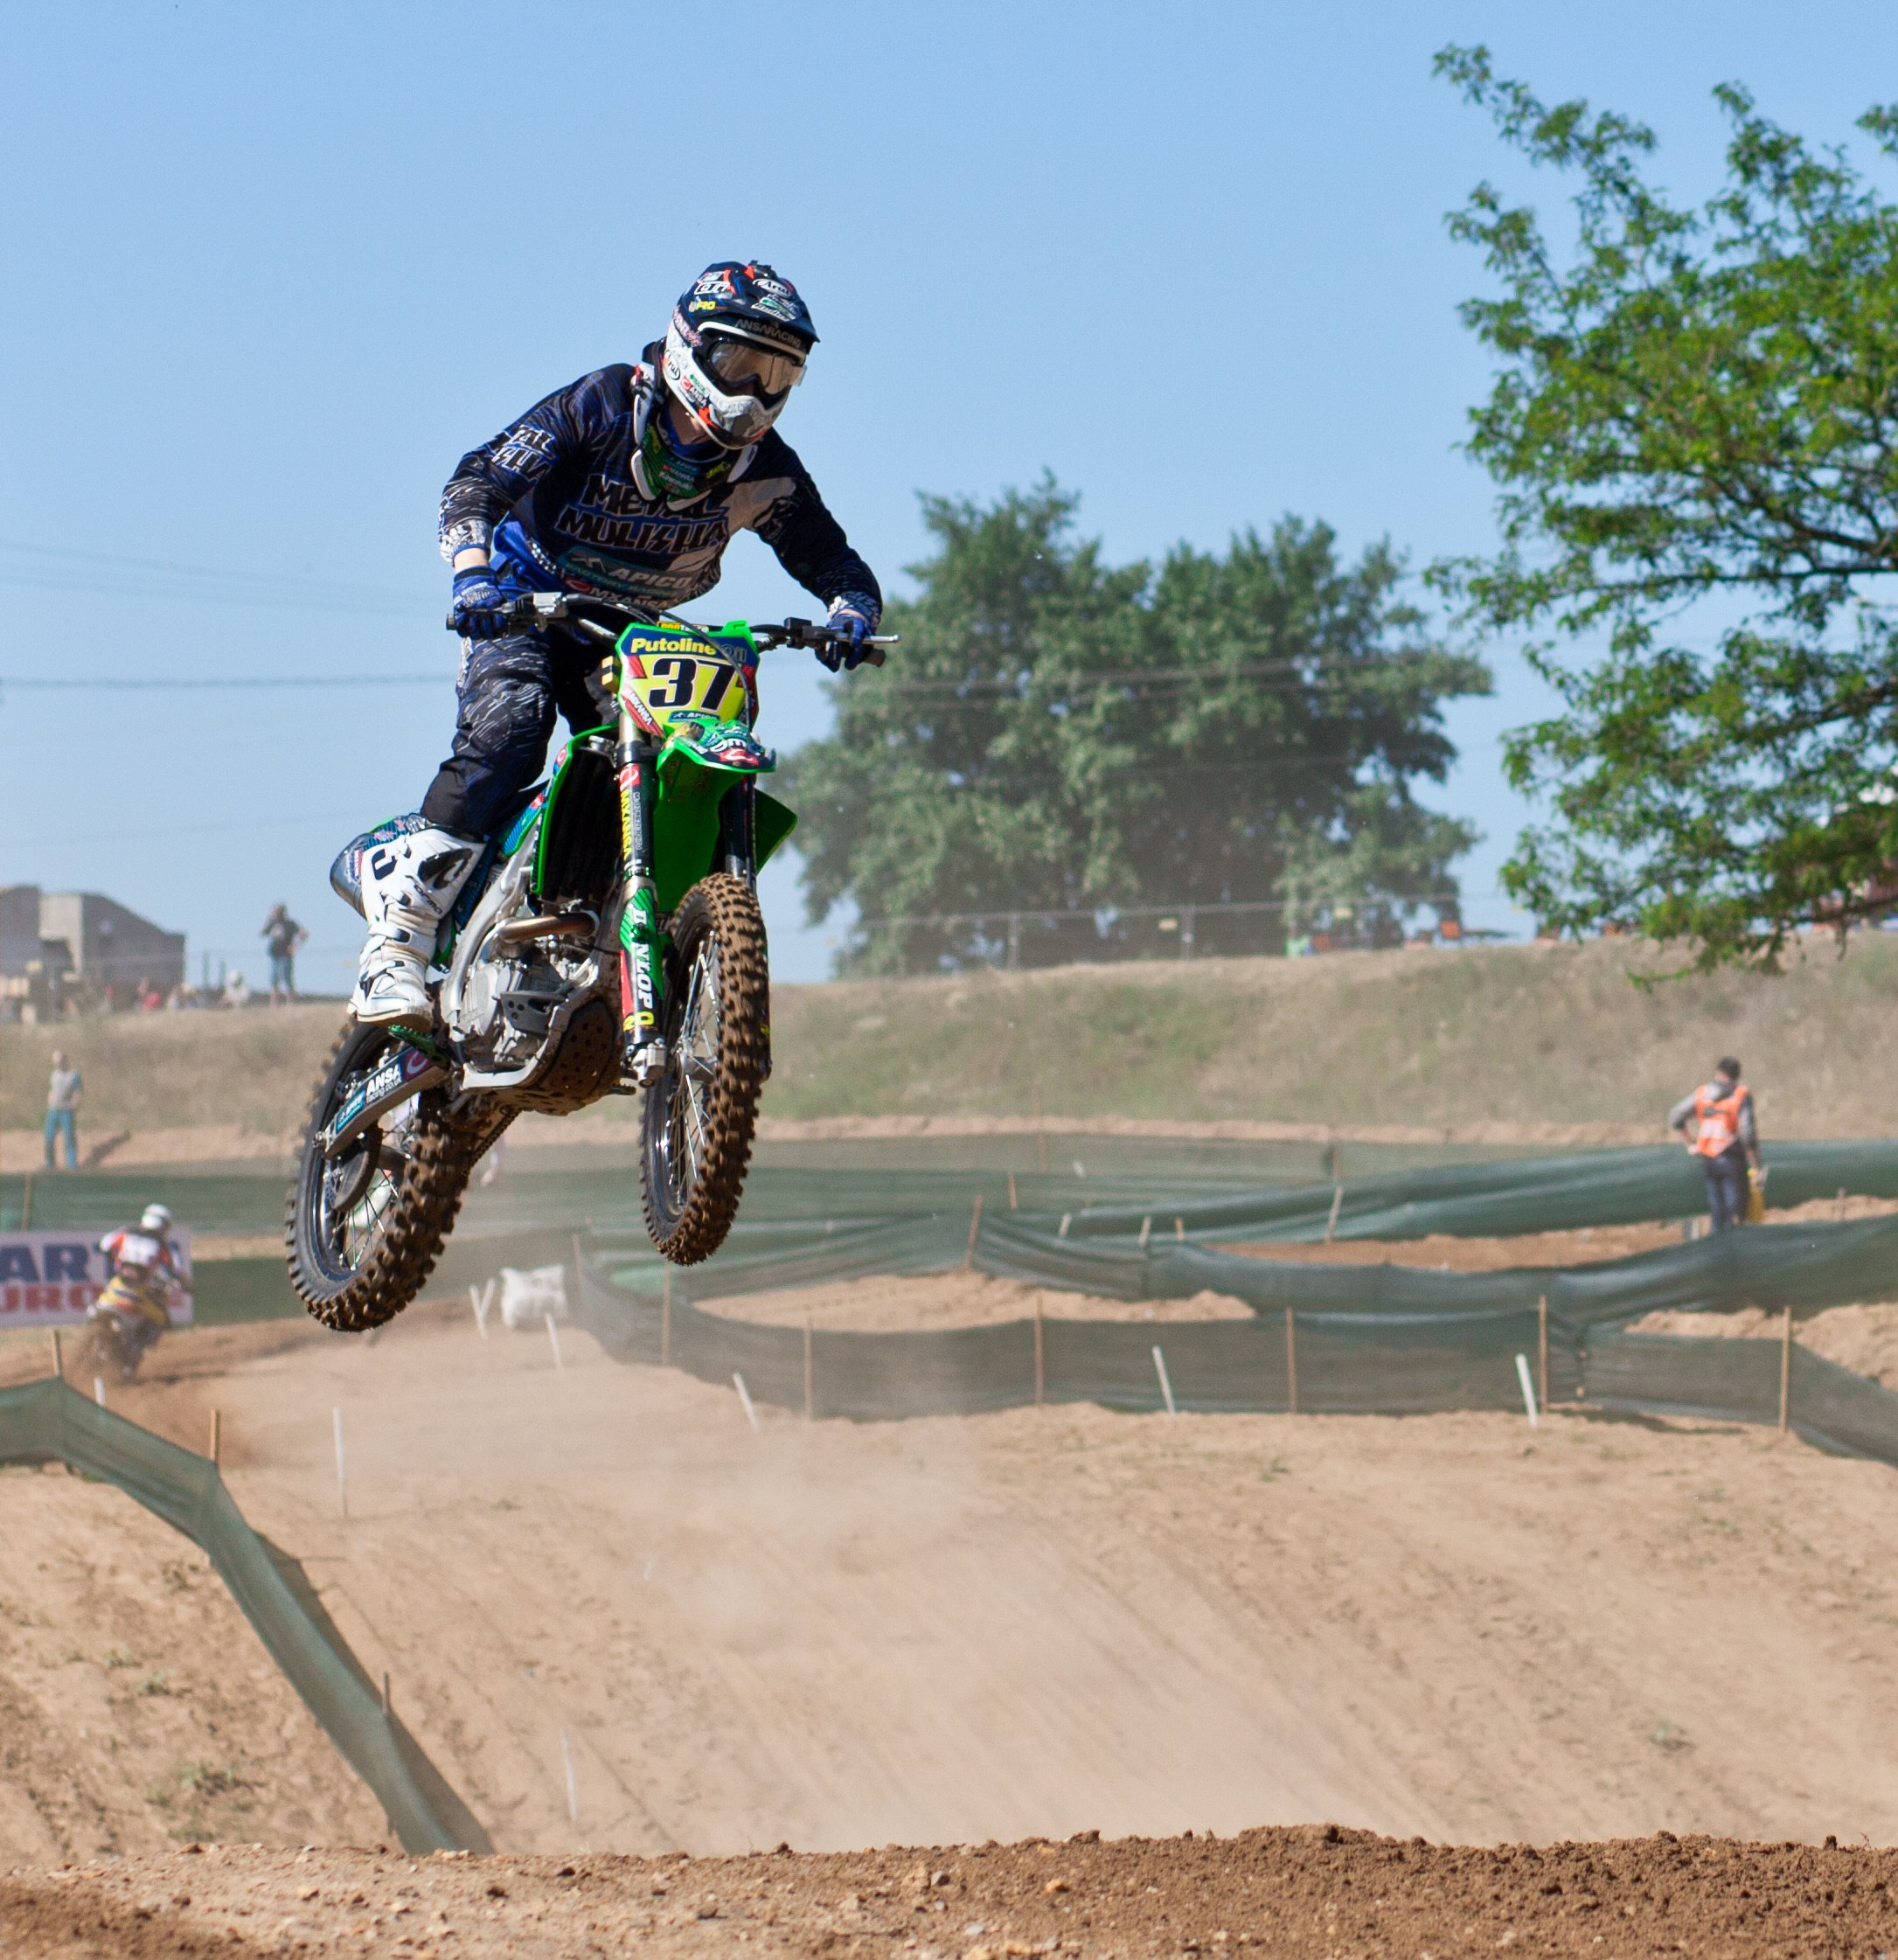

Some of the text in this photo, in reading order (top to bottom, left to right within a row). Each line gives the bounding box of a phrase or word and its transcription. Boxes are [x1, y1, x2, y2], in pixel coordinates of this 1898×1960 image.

[553, 504, 730, 555] MULISHA
[608, 567, 694, 589] APICO
[648, 657, 737, 711] 37
[631, 908, 654, 1009] DNLOP
[366, 1063, 402, 1097] ANSA
